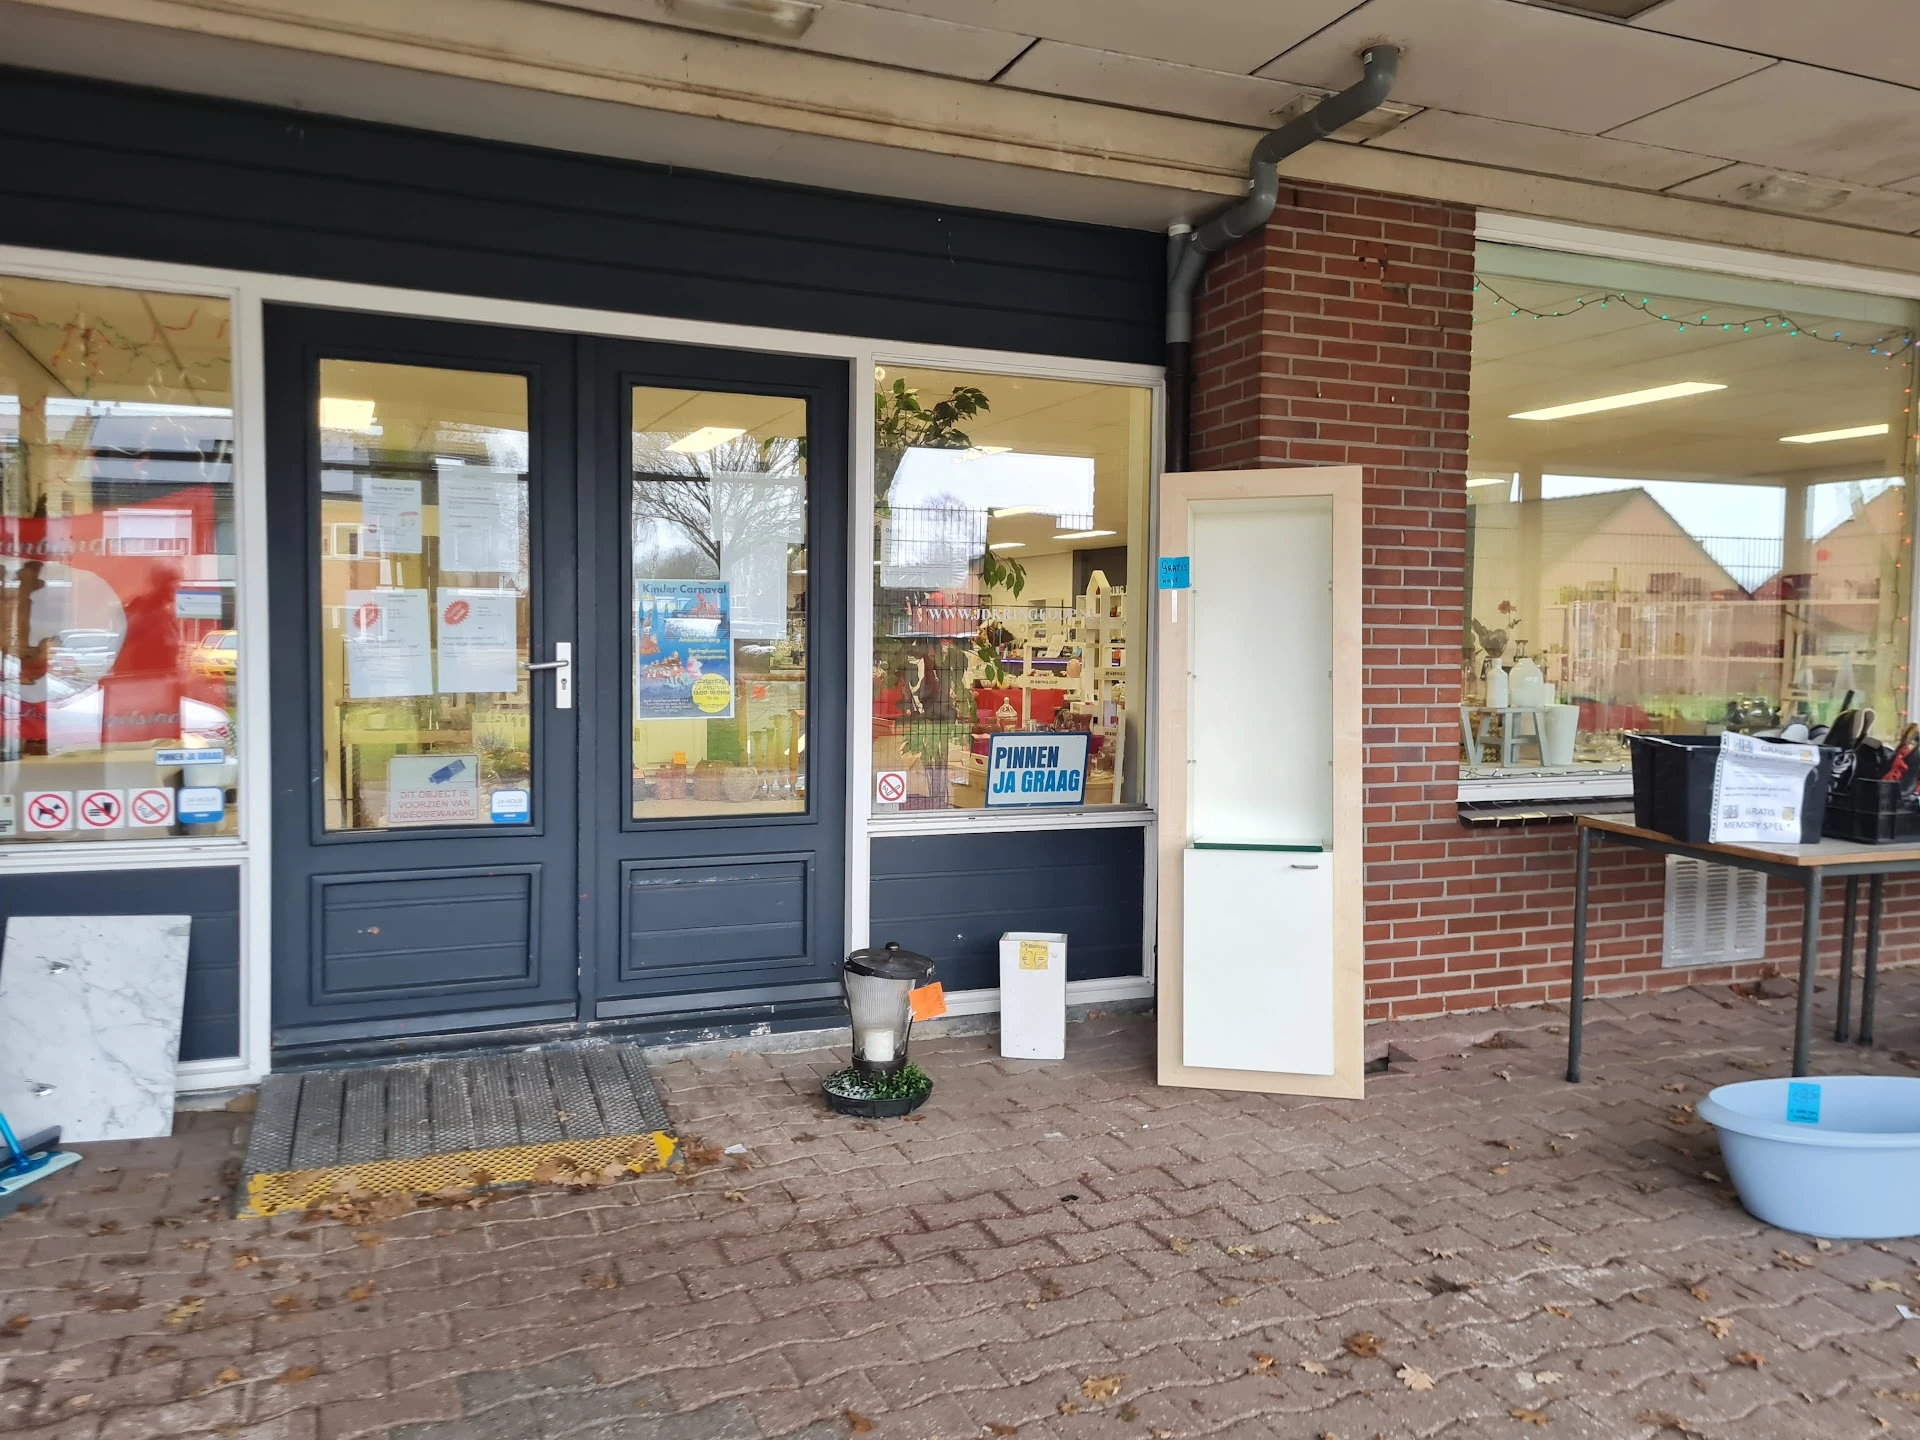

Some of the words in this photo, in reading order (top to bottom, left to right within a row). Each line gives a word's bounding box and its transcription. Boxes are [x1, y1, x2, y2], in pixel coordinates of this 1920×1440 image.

[642, 584, 678, 594] Kinder
[680, 584, 727, 594] Carnaval
[994, 745, 1061, 770] PINNEN
[992, 770, 1016, 794] JA
[1021, 769, 1081, 793] GRAAG
[400, 791, 415, 799] DIT
[418, 790, 457, 799] OBJECT
[459, 789, 469, 798] IS
[397, 800, 449, 809] VOORZIEN
[451, 799, 471, 807] VAN
[392, 808, 476, 819] VIDEOBEWAKING
[1745, 807, 1776, 817] GRATIS
[1723, 821, 1761, 830] MEMORY
[1762, 822, 1784, 831] SPEL
